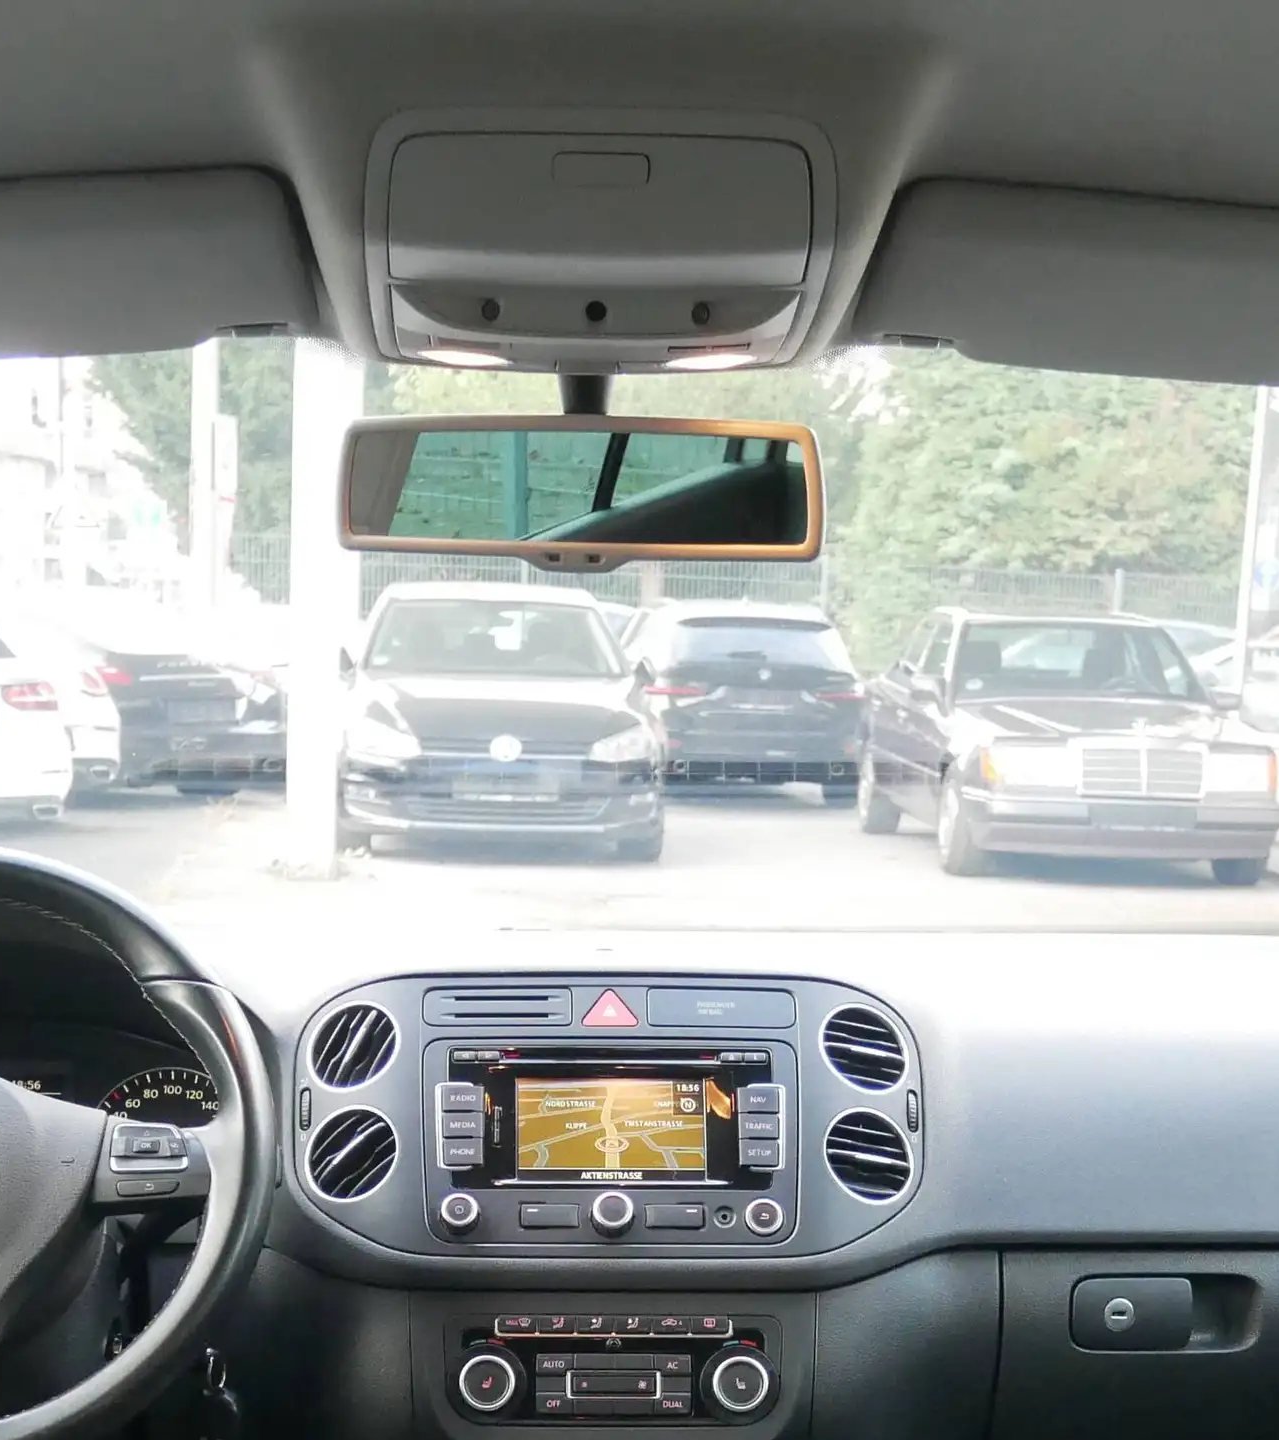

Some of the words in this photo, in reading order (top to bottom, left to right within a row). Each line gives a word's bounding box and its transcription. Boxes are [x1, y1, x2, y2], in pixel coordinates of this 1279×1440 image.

[163, 1085, 182, 1095] 100
[676, 1083, 700, 1092] 18:56
[143, 1089, 158, 1098] 80
[185, 1090, 203, 1100] 120
[449, 1094, 476, 1102] RADIO
[125, 1099, 141, 1108] 60
[201, 1101, 219, 1111] 140
[449, 1121, 476, 1129] MEDIA
[745, 1122, 774, 1130] TRAFFIC
[449, 1148, 475, 1156] PHONE
[747, 1149, 772, 1157] SETUP
[580, 1171, 643, 1180] AKTIENSTRASSE
[543, 1360, 565, 1369] AUTO
[666, 1361, 679, 1370] AC
[546, 1400, 561, 1408] OFF
[662, 1400, 683, 1409] DUAL
